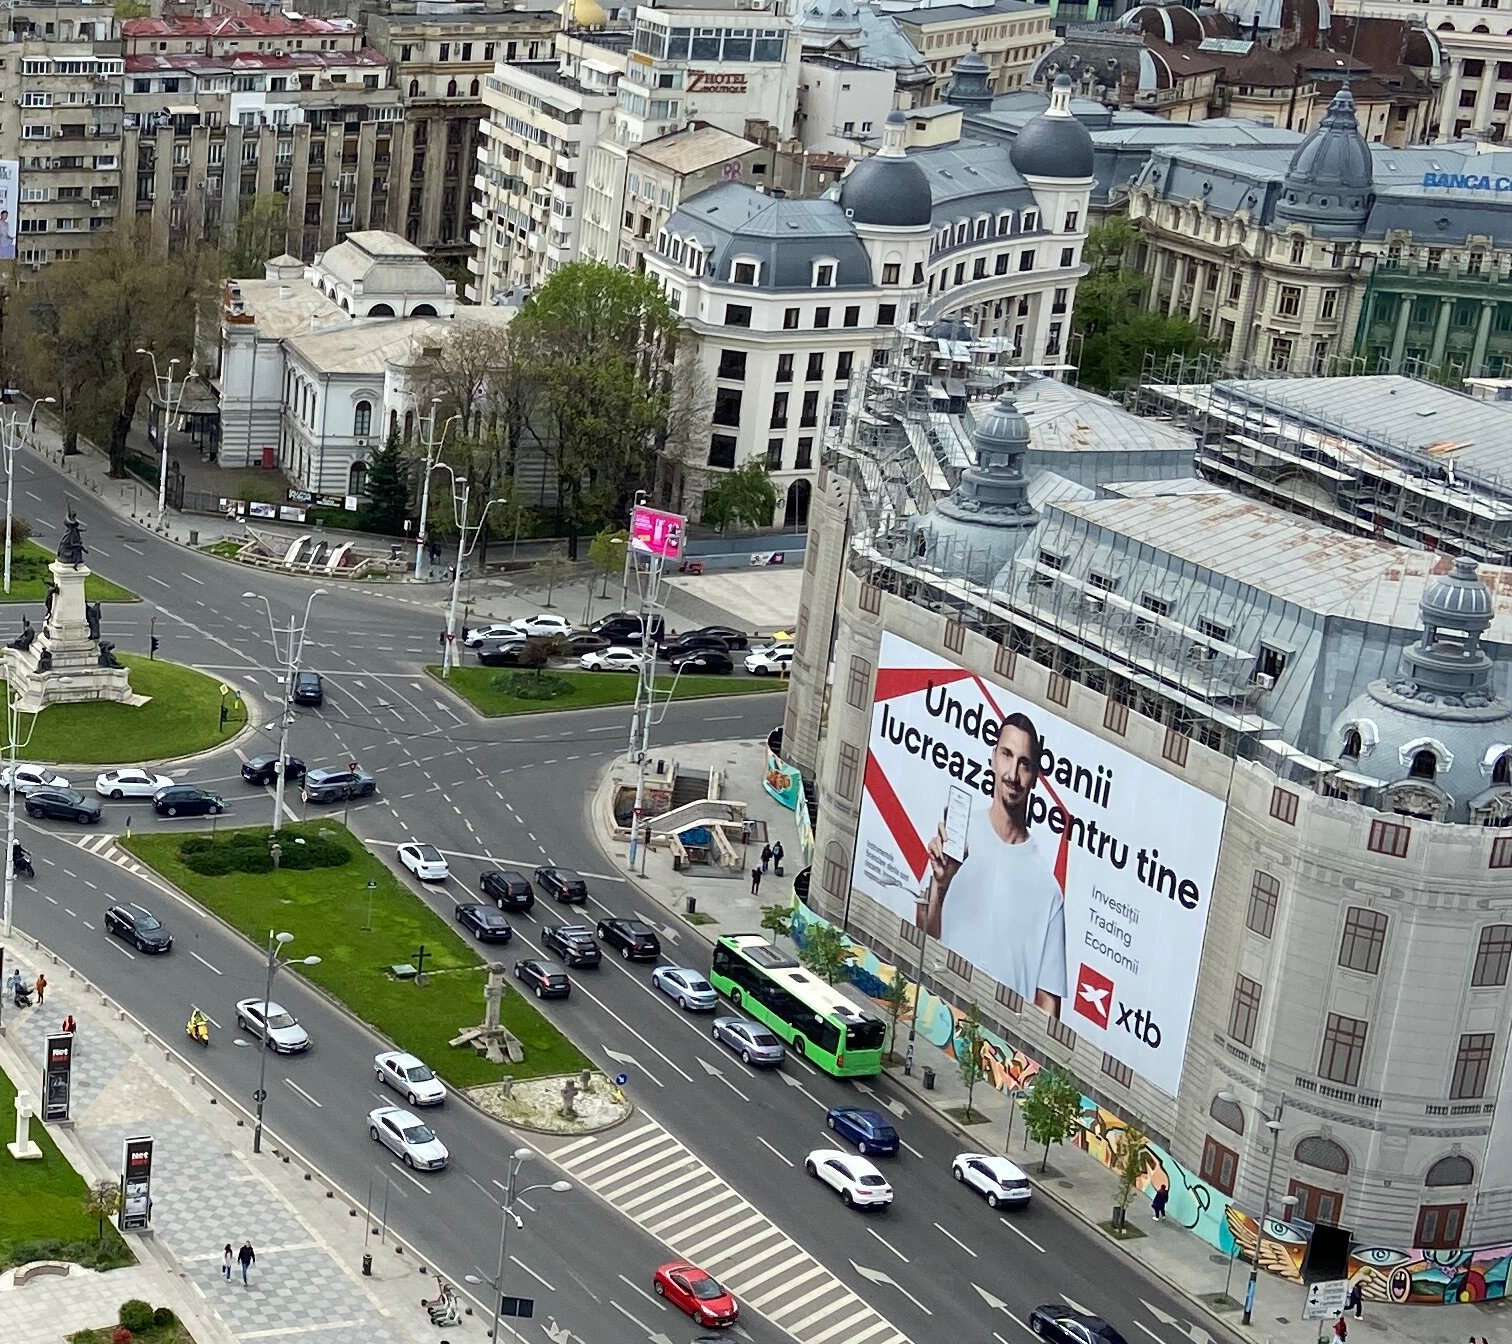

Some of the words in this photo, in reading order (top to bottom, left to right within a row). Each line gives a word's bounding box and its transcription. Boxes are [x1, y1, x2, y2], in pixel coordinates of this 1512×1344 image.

[704, 74, 748, 84] HOTEL
[1423, 172, 1490, 190] BANCA
[925, 679, 1001, 747] Unde
[1038, 735, 1113, 809] banii
[1026, 793, 1129, 870] pentru
[1137, 849, 1199, 910] tine
[1089, 908, 1132, 948] Trading
[1085, 931, 1139, 975] Economii
[1115, 1001, 1162, 1049] xtb
